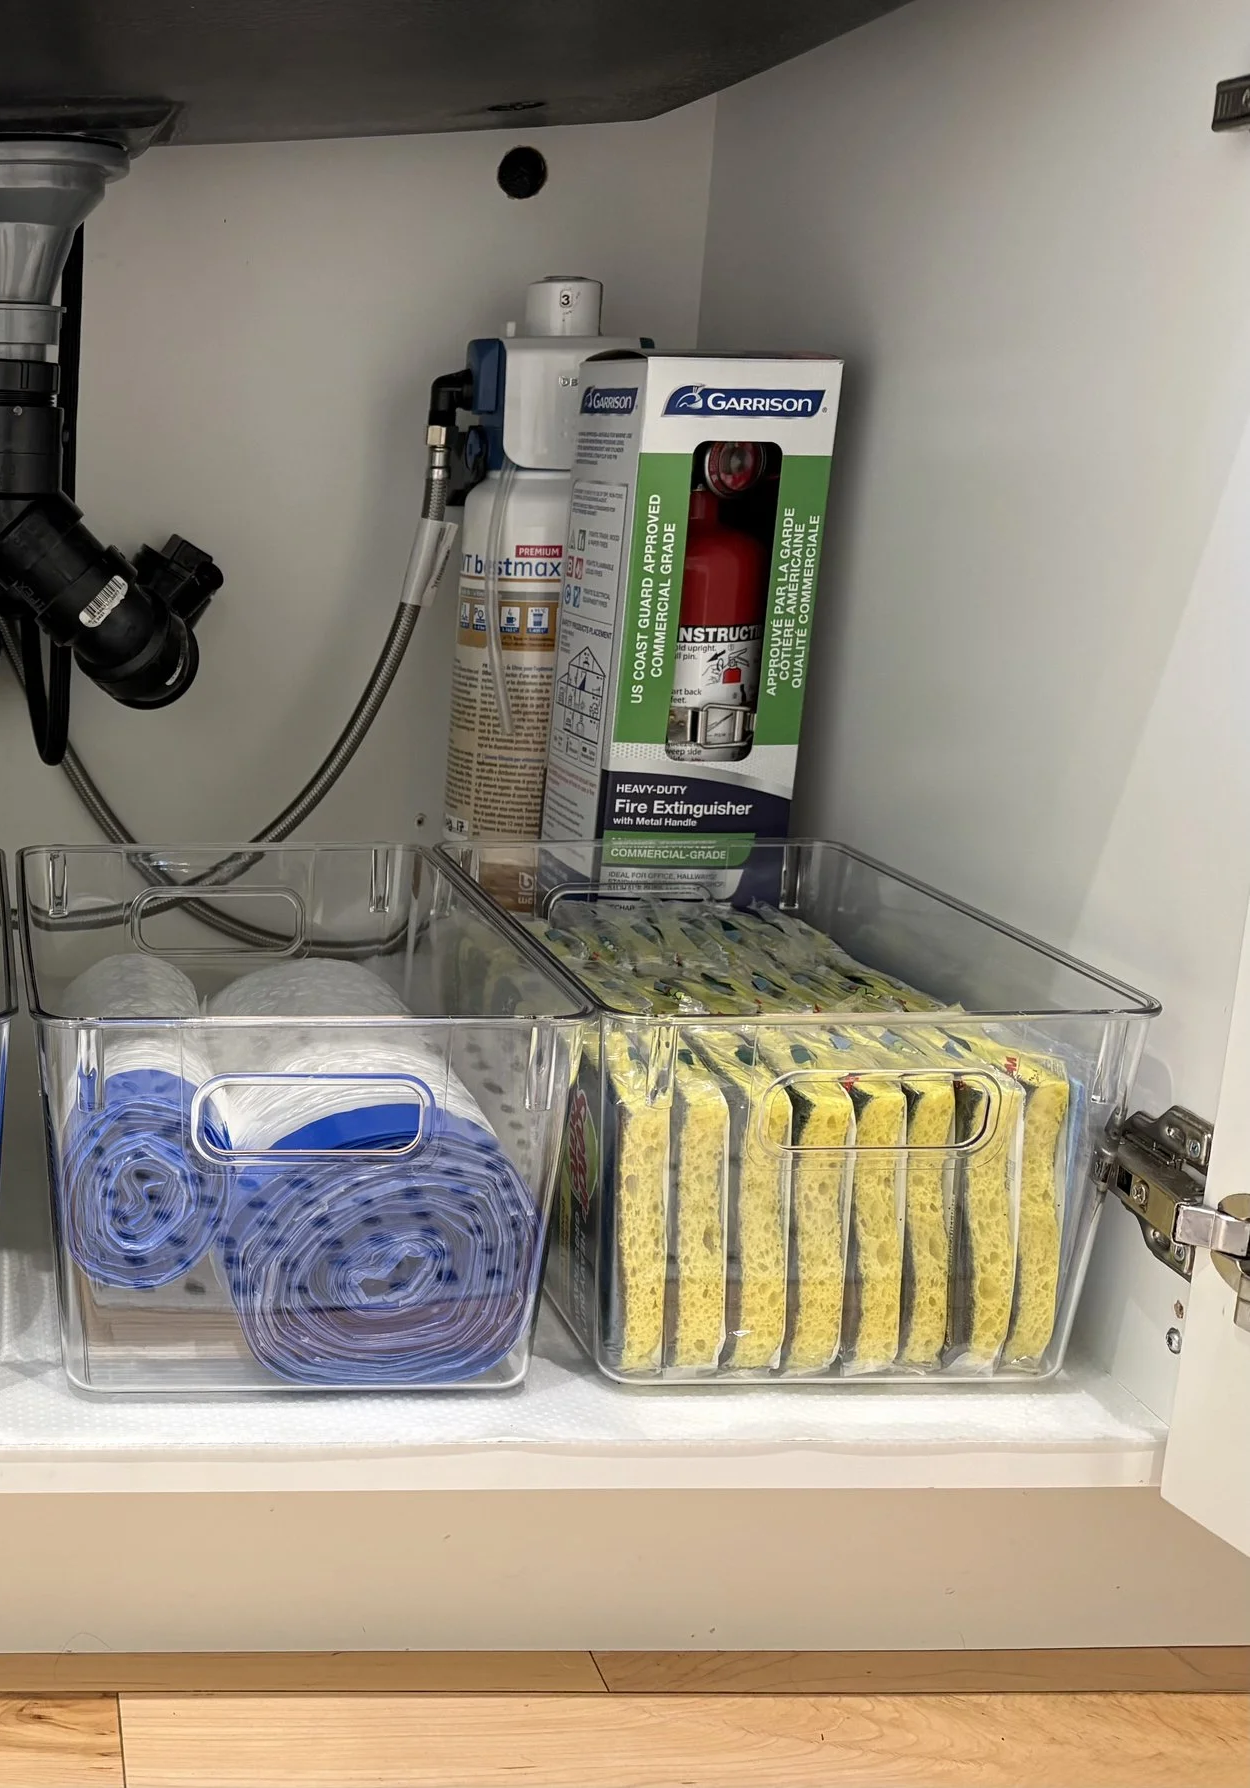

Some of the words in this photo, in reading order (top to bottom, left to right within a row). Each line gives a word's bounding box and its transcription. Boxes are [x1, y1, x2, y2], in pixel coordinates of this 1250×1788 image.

[561, 294, 570, 306] 3
[593, 393, 632, 409] GARRISON
[707, 392, 813, 413] GARRISON
[643, 494, 661, 574] APPROVED
[780, 508, 795, 559] GARDE
[519, 547, 559, 556] PREMIUM
[475, 554, 562, 577] bstmax
[778, 564, 789, 581] LA
[798, 515, 820, 624] COMMERCIALE
[638, 577, 654, 628] GUARD
[650, 578, 671, 678] COMMERCIAL
[661, 523, 676, 574] GRADE
[774, 586, 786, 614] PAR
[634, 635, 648, 680] COAST
[683, 653, 697, 661] pin.
[689, 645, 716, 654] upright.
[766, 620, 783, 696] APPROUVÉ
[792, 628, 807, 688] QUALITÉ
[631, 684, 643, 704] US
[616, 783, 687, 795] HEAVY-DUTY
[615, 799, 648, 813] Fire
[653, 800, 752, 818] Extinguisher
[613, 817, 633, 825] with
[636, 818, 662, 826] Metal
[665, 818, 697, 827] Handle
[610, 849, 726, 859] COMMERCIAL-GRADE
